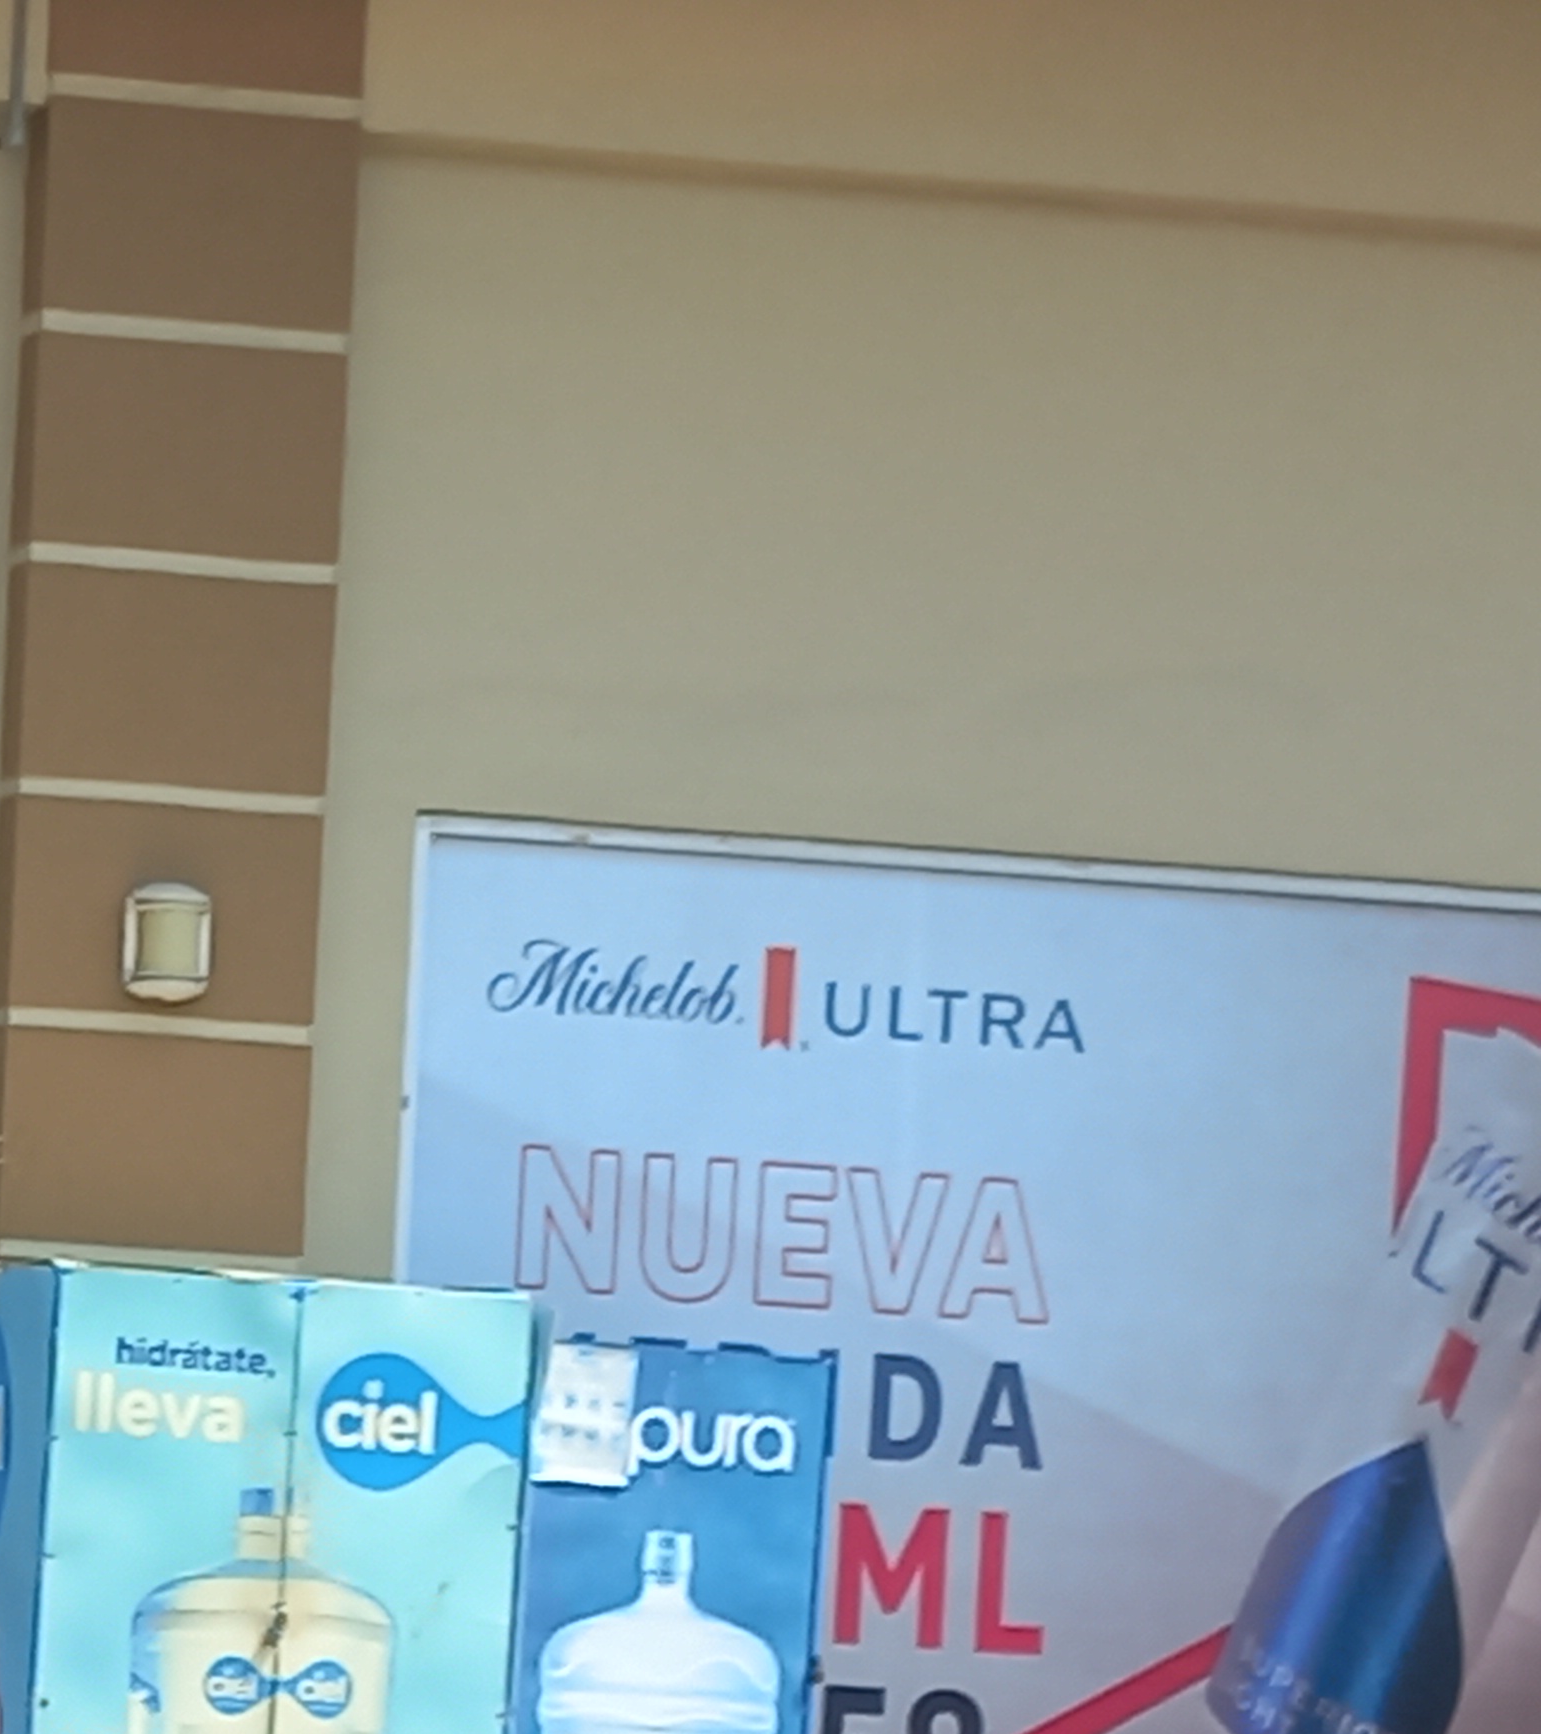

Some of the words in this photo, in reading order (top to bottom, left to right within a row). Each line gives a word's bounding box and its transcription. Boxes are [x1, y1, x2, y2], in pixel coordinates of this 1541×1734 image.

[488, 938, 741, 1026] Michelob
[824, 979, 1086, 1054] ULTRA
[515, 1143, 1050, 1325] NUEVA
[73, 1369, 244, 1443] lleva
[115, 1336, 276, 1379] hidrátate,
[323, 1378, 439, 1456] ciel
[831, 1502, 1045, 1656] ML
